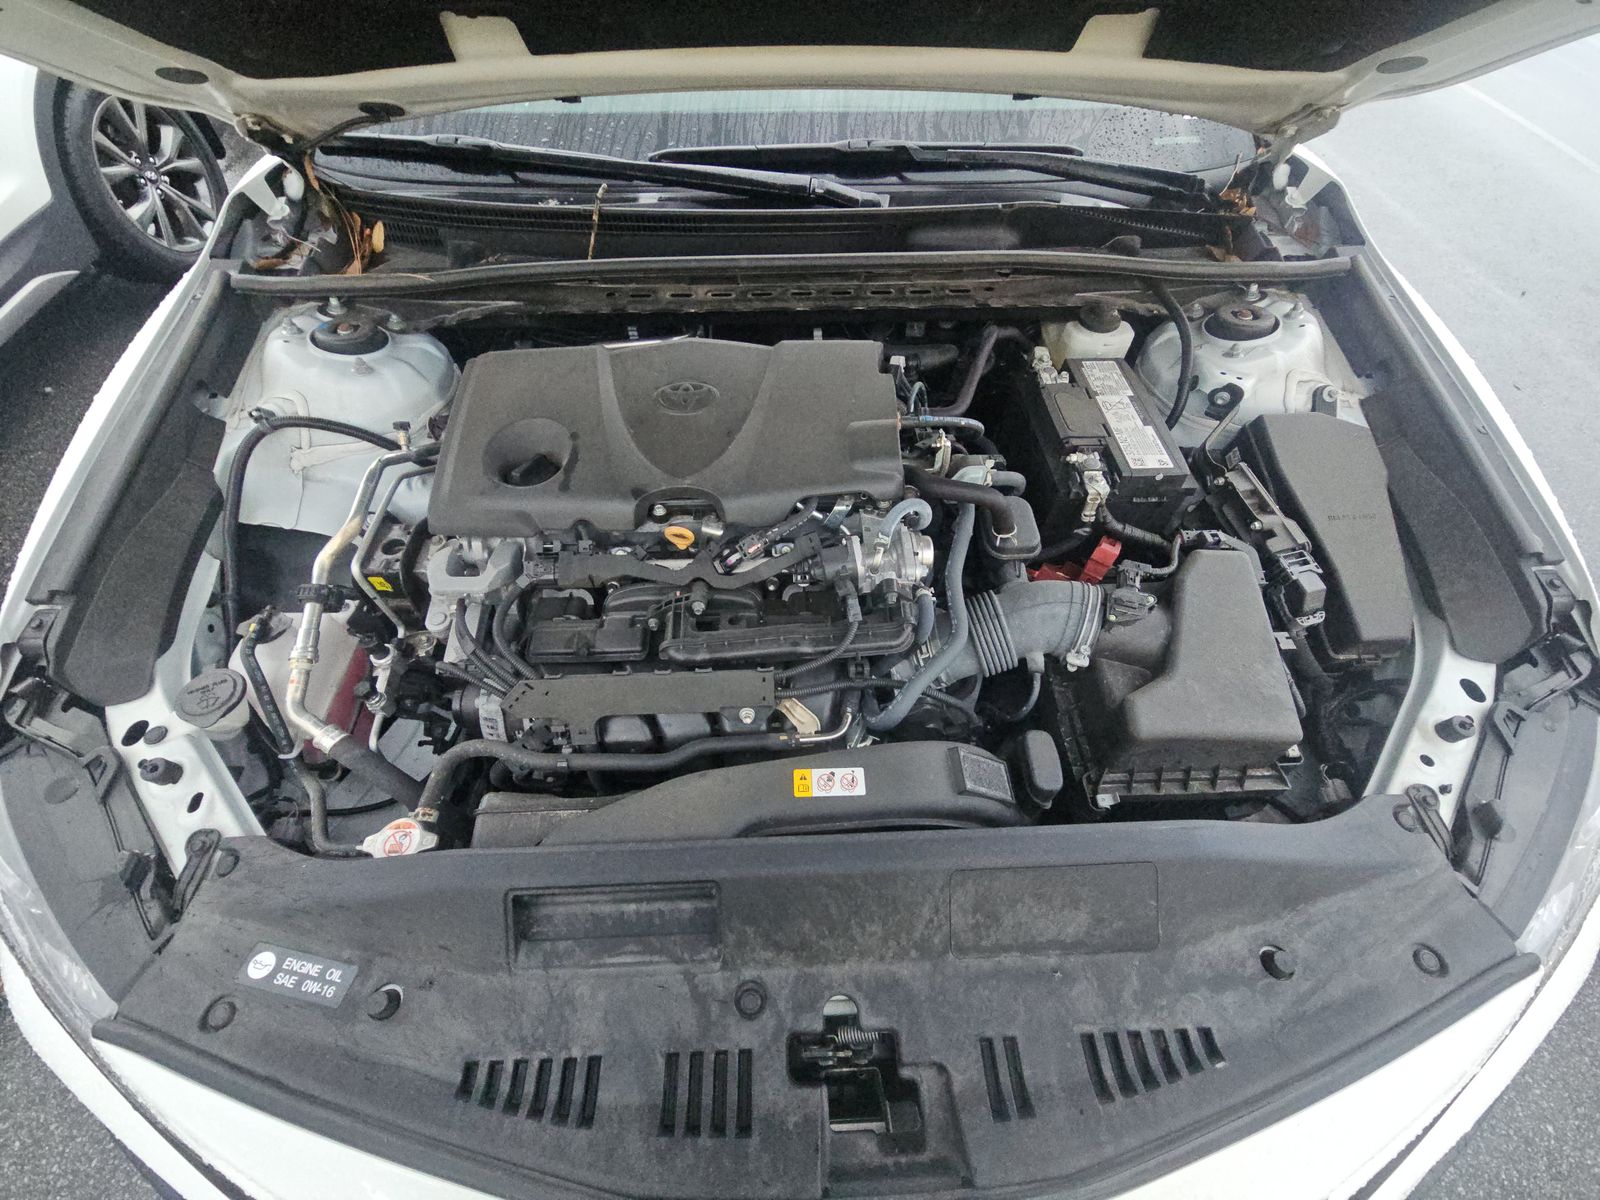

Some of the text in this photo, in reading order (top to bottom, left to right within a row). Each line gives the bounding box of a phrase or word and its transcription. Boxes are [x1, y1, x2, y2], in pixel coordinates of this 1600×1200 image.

[282, 957, 342, 983] ENGINE OIL
[273, 972, 336, 998] SAE 0W-16
